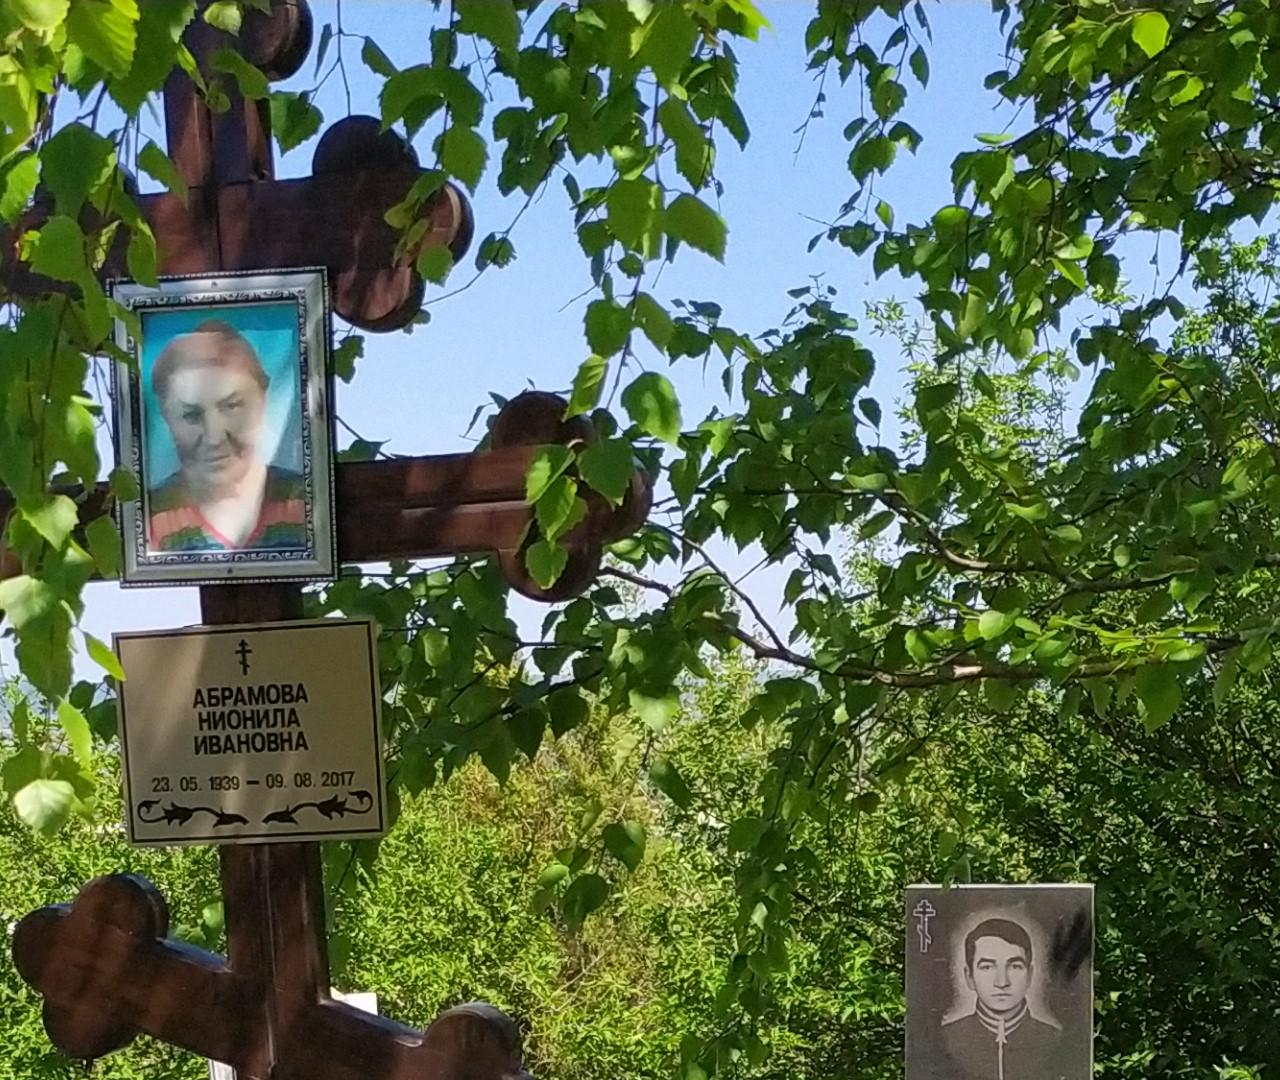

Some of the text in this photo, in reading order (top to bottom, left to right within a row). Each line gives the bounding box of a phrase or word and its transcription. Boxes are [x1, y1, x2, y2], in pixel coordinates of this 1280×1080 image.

[193, 682, 309, 709] АБРАМОВА
[198, 707, 301, 732] НИОНИЛА
[193, 730, 309, 756] ИВАНОВНА
[209, 774, 241, 791] 1939
[321, 770, 356, 788] 2017
